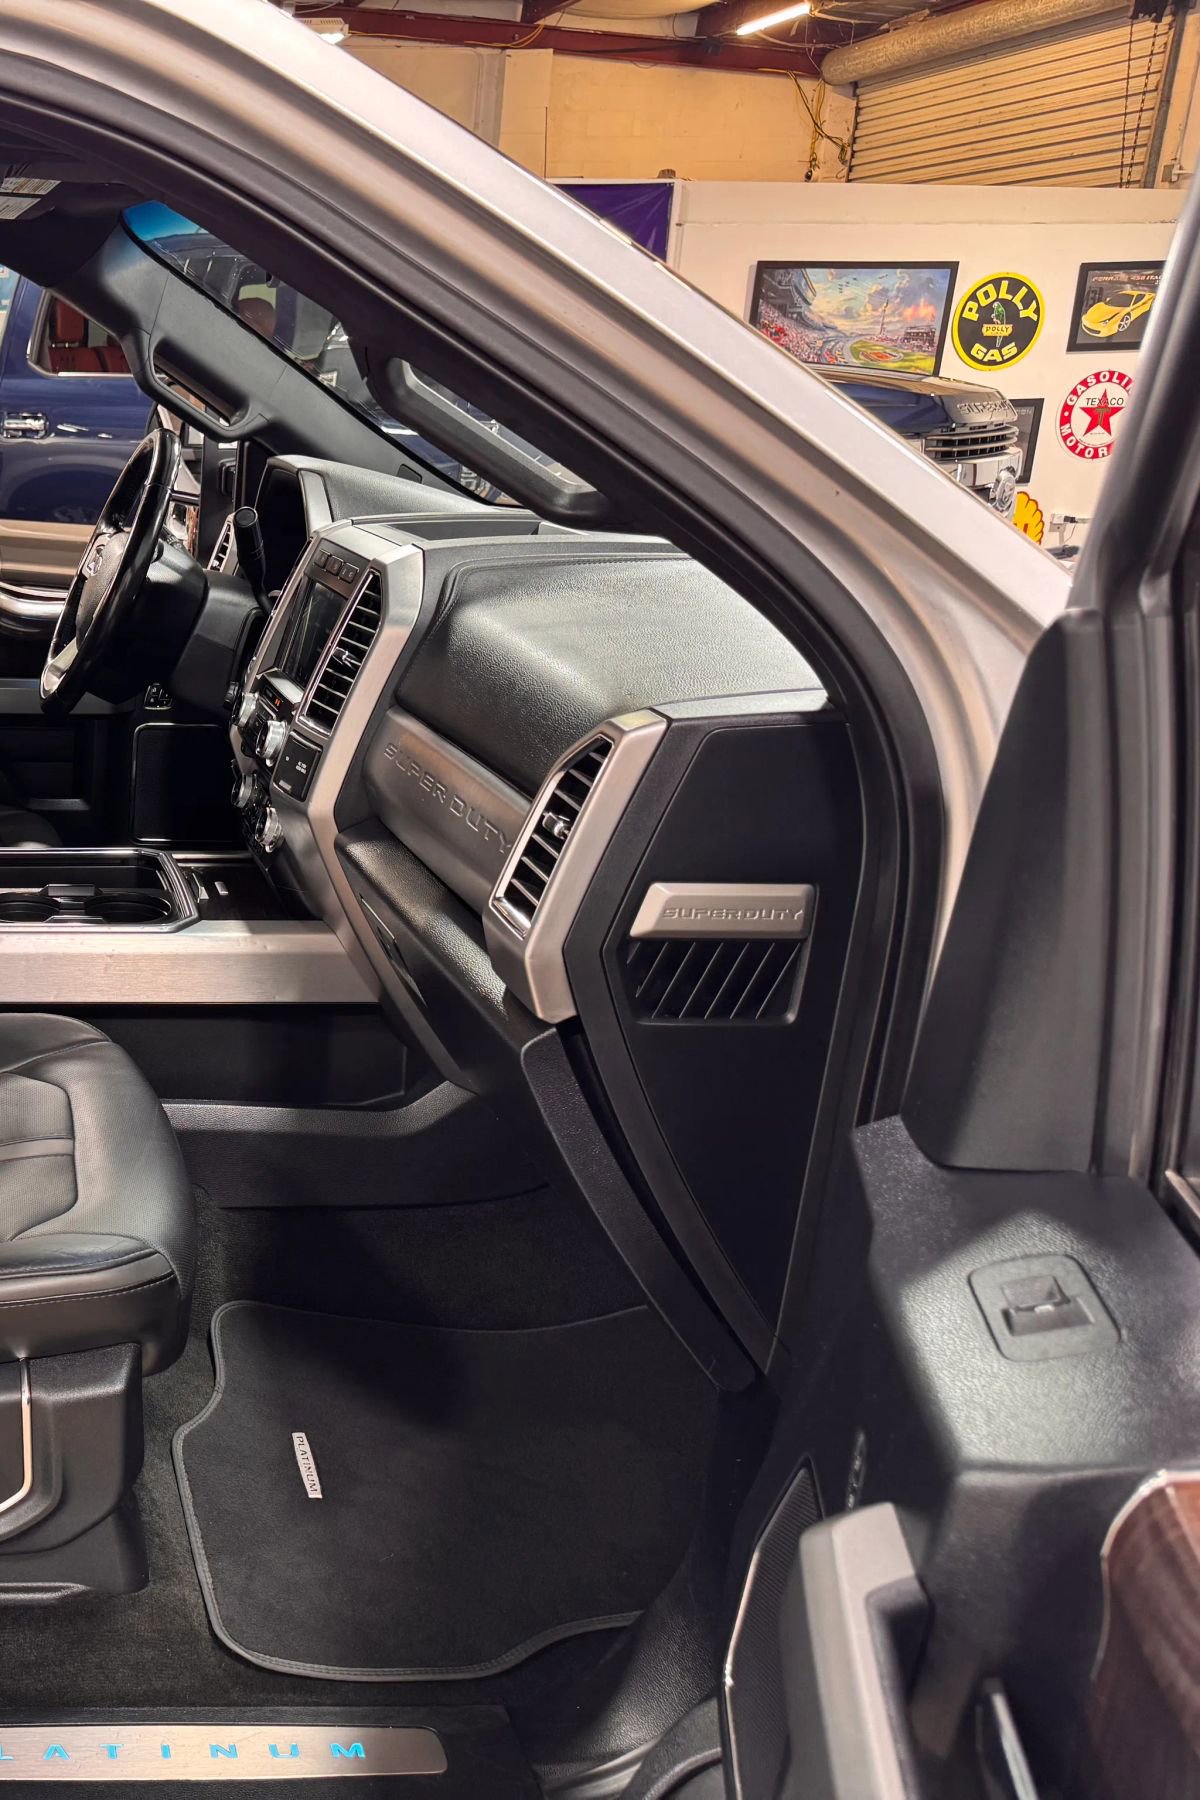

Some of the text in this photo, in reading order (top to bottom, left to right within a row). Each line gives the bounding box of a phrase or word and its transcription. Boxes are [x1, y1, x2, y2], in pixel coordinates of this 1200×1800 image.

[962, 280, 1038, 321] POLLY
[970, 342, 1018, 362] GAS
[1086, 397, 1124, 406] TEXACO
[1060, 422, 1108, 458] MOTOR
[383, 743, 513, 854] SUPER DUTY
[295, 1435, 319, 1492] PLATINUM
